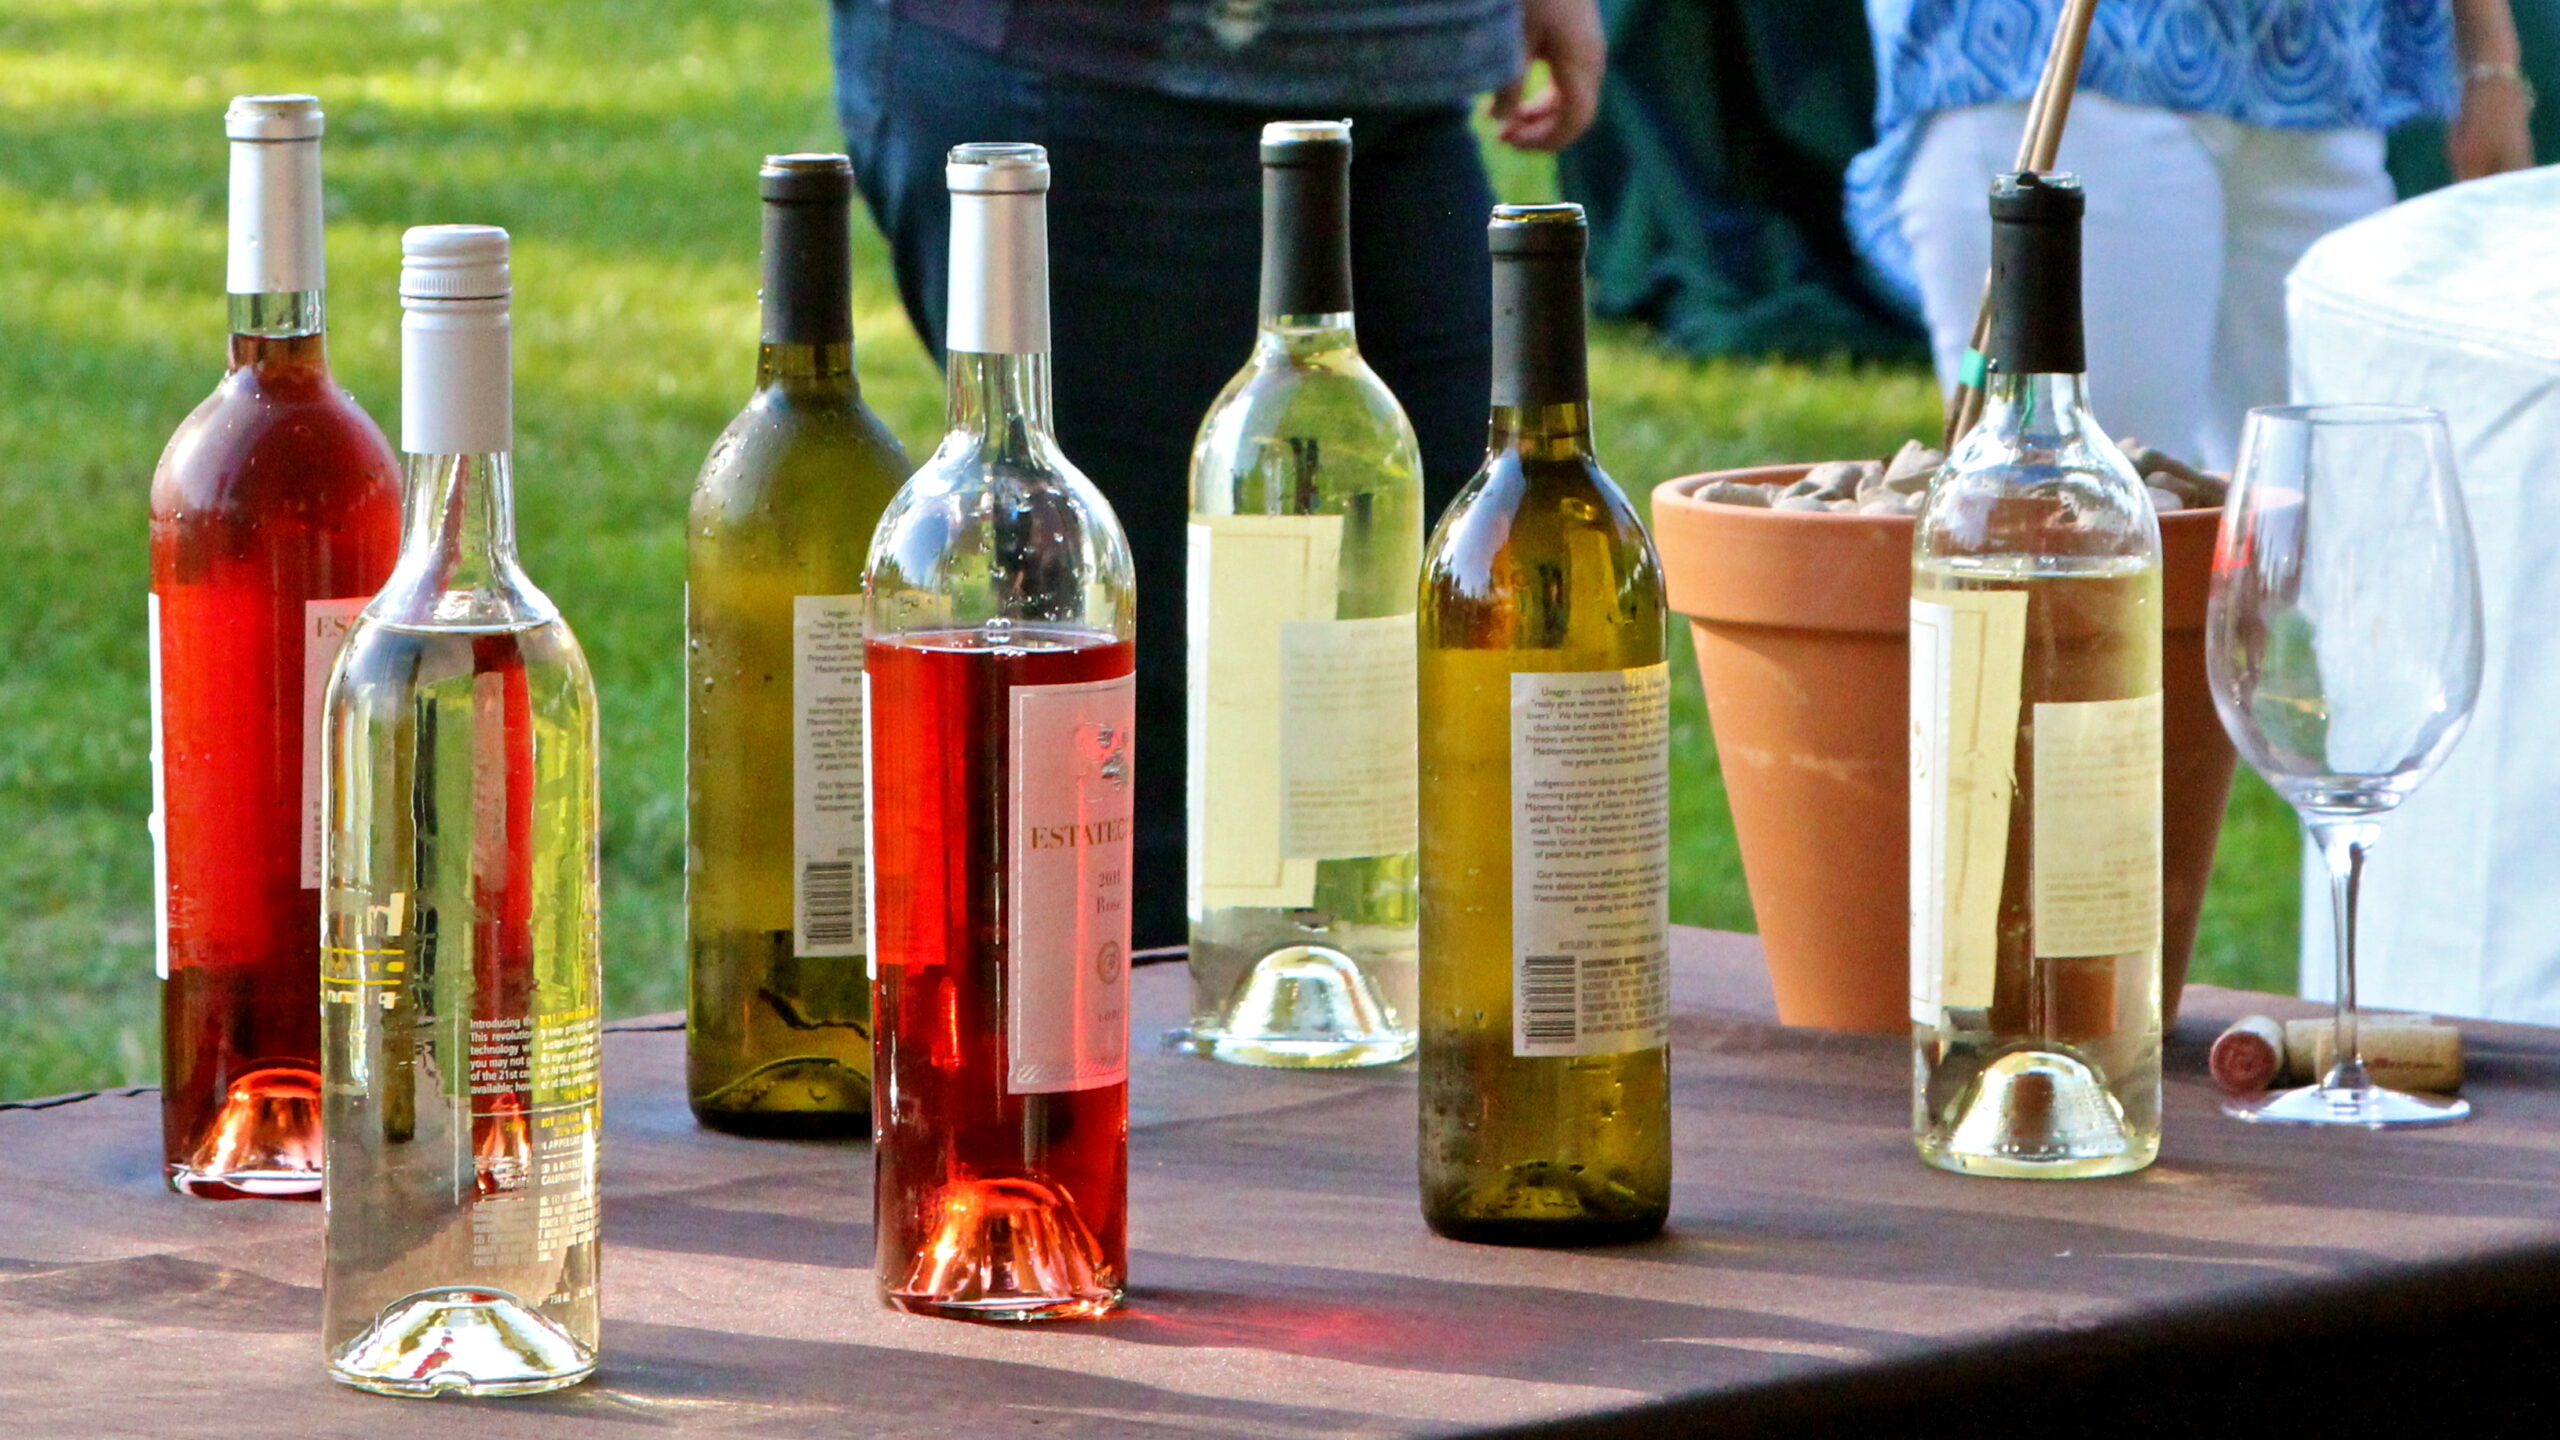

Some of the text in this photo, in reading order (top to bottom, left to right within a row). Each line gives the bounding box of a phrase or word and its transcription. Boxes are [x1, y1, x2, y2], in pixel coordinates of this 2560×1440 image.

[1533, 723, 1570, 732] chocolate
[1533, 747, 1589, 756] Mediterranean
[1534, 779, 1575, 789] Indigenous
[1526, 791, 1564, 801] becoming
[470, 1017, 521, 1029] Introducing
[470, 1032, 488, 1042] This
[470, 1045, 519, 1056] technology
[470, 1057, 524, 1070] you may not
[470, 1071, 480, 1081] of
[482, 1070, 497, 1081] the
[498, 1070, 518, 1080] 21st
